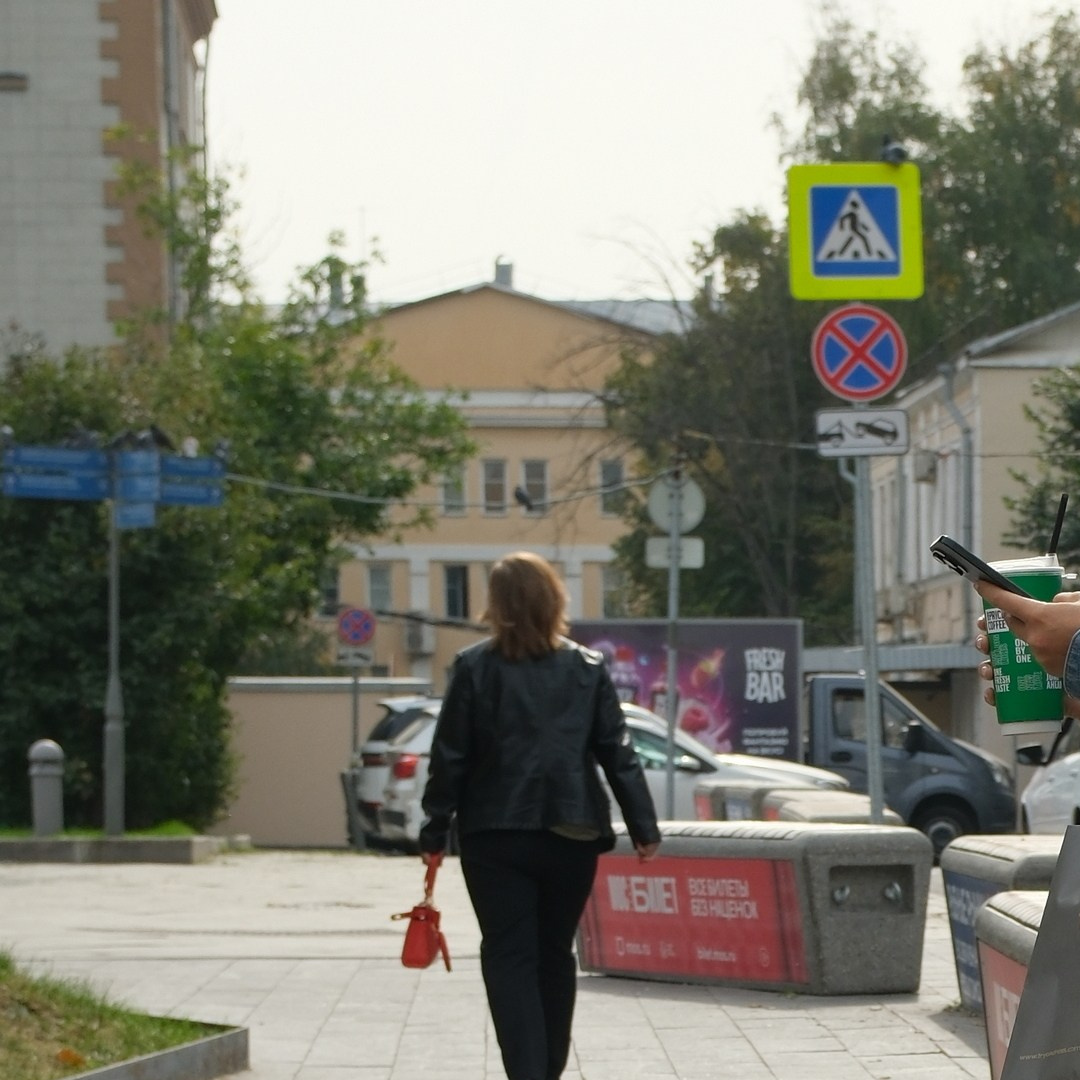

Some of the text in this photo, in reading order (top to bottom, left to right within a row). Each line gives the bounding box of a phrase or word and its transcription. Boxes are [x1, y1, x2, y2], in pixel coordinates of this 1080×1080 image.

[988, 620, 1006, 630] COFFEE
[1015, 646, 1025, 655] BY
[744, 647, 786, 671] FRESH
[1016, 655, 1031, 663] ONE
[744, 671, 787, 703] BAR
[995, 684, 1010, 692] TASTE
